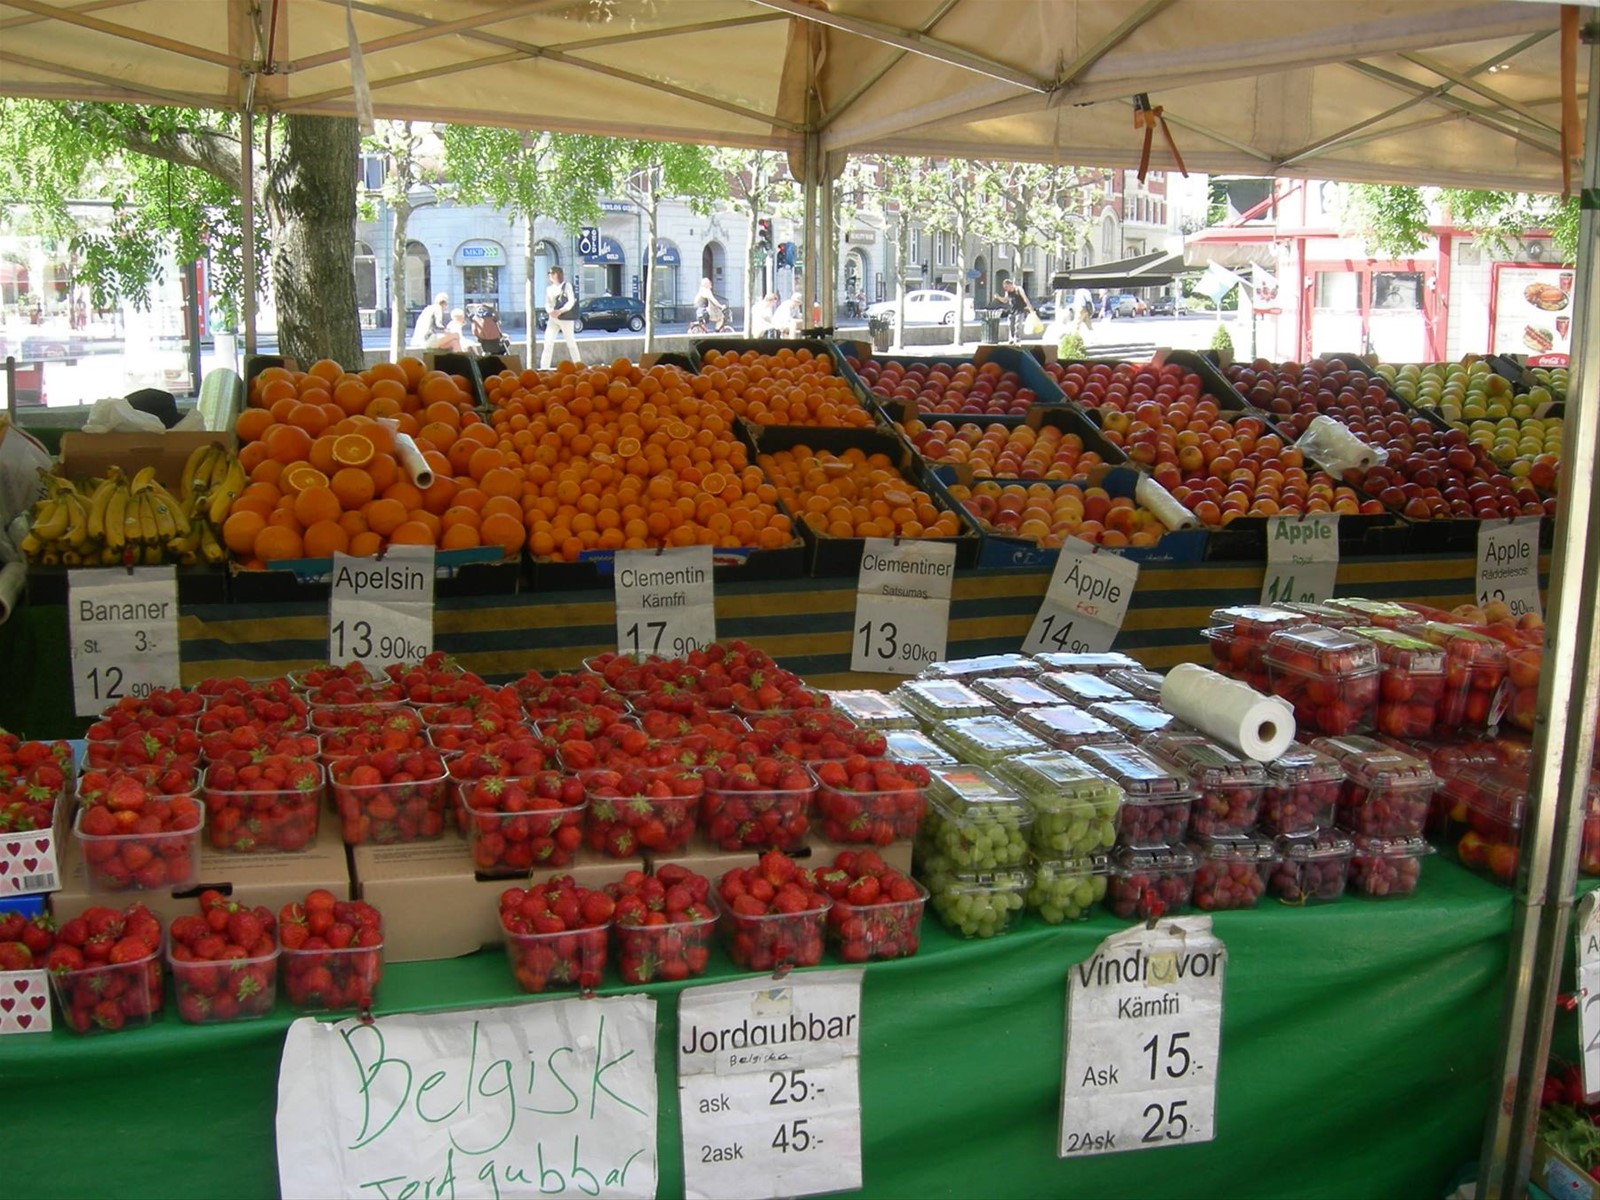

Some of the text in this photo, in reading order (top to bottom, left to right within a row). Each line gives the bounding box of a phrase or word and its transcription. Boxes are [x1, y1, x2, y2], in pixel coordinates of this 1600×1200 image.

[1274, 517, 1331, 545] Äpple
[862, 554, 952, 576] Clementiner
[1485, 536, 1530, 566] Äpple
[335, 566, 424, 594] Apelsin
[620, 566, 705, 588] Clementin
[1064, 558, 1121, 603] Äpple
[641, 591, 686, 608] Kärnfri
[881, 585, 929, 599] Satsumas
[80, 600, 169, 622] Bananer
[1118, 993, 1180, 1019] Kärnfri
[1082, 1031, 1204, 1087] Ask 15:-
[340, 1015, 650, 1154] Belgisk
[699, 1069, 825, 1113] ask 25:-
[701, 1119, 824, 1163] 2ask 45:-
[1066, 1131, 1116, 1152] 2Ask
